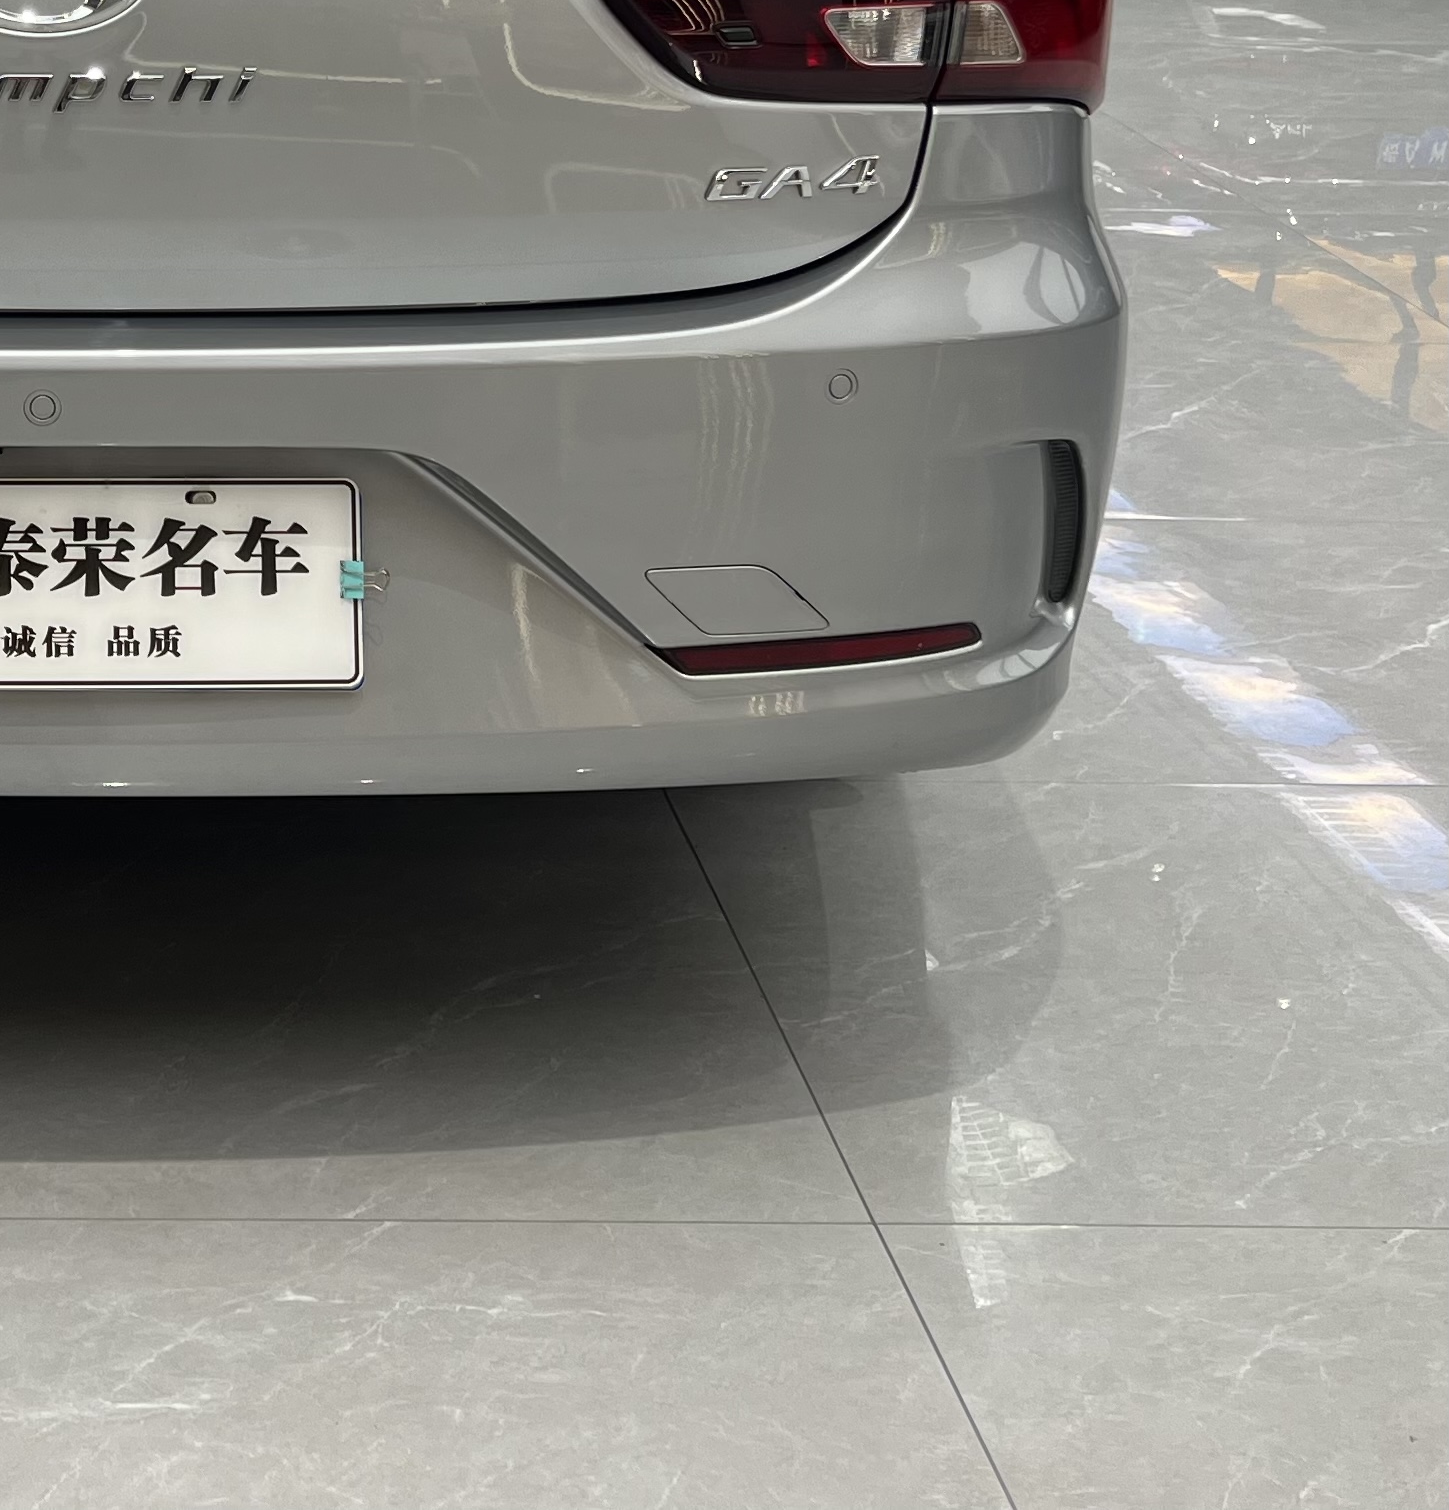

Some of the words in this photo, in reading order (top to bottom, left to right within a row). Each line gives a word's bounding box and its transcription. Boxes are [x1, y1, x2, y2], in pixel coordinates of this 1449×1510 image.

[705, 154, 882, 202] GA4
[0, 625, 77, 659] 诚信
[105, 625, 183, 659] 品质
